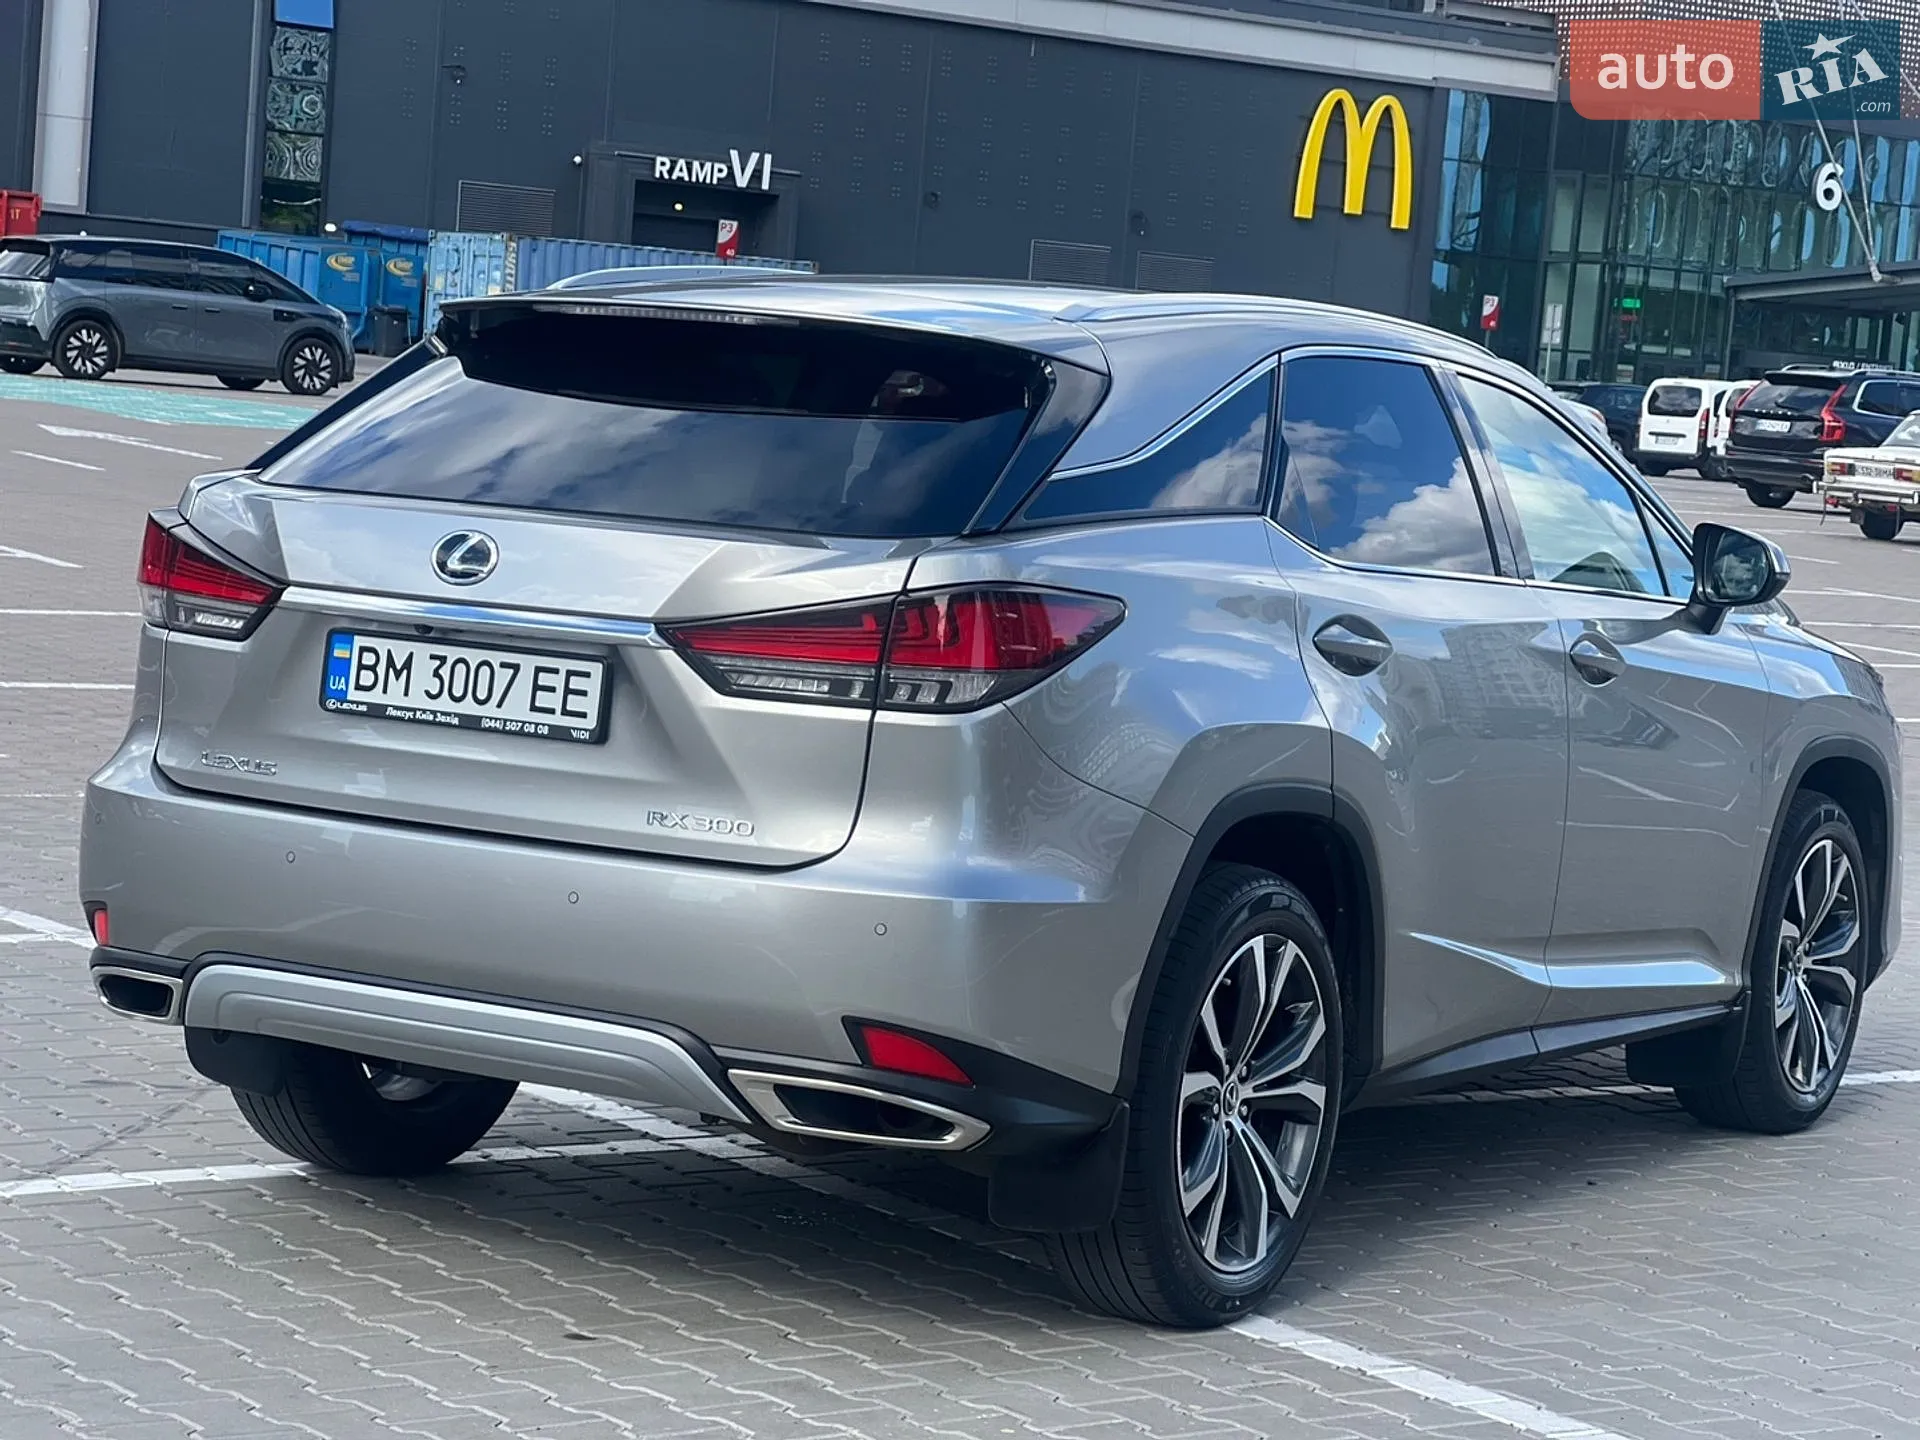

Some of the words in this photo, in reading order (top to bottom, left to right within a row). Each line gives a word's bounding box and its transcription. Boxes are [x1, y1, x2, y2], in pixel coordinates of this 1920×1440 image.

[654, 156, 728, 185] RAMP
[729, 149, 772, 190] VI
[1814, 162, 1844, 211] 6
[720, 222, 734, 233] P3
[329, 675, 347, 691] UA
[354, 645, 414, 697] BM
[424, 653, 521, 709] 3007
[529, 665, 592, 719] EE
[386, 706, 414, 720] Лексус
[481, 717, 504, 730] (044)
[505, 721, 522, 731] 507
[524, 723, 536, 734] 08
[537, 724, 549, 735] 08
[571, 729, 590, 740] VIDI
[200, 751, 277, 776] LEXUS
